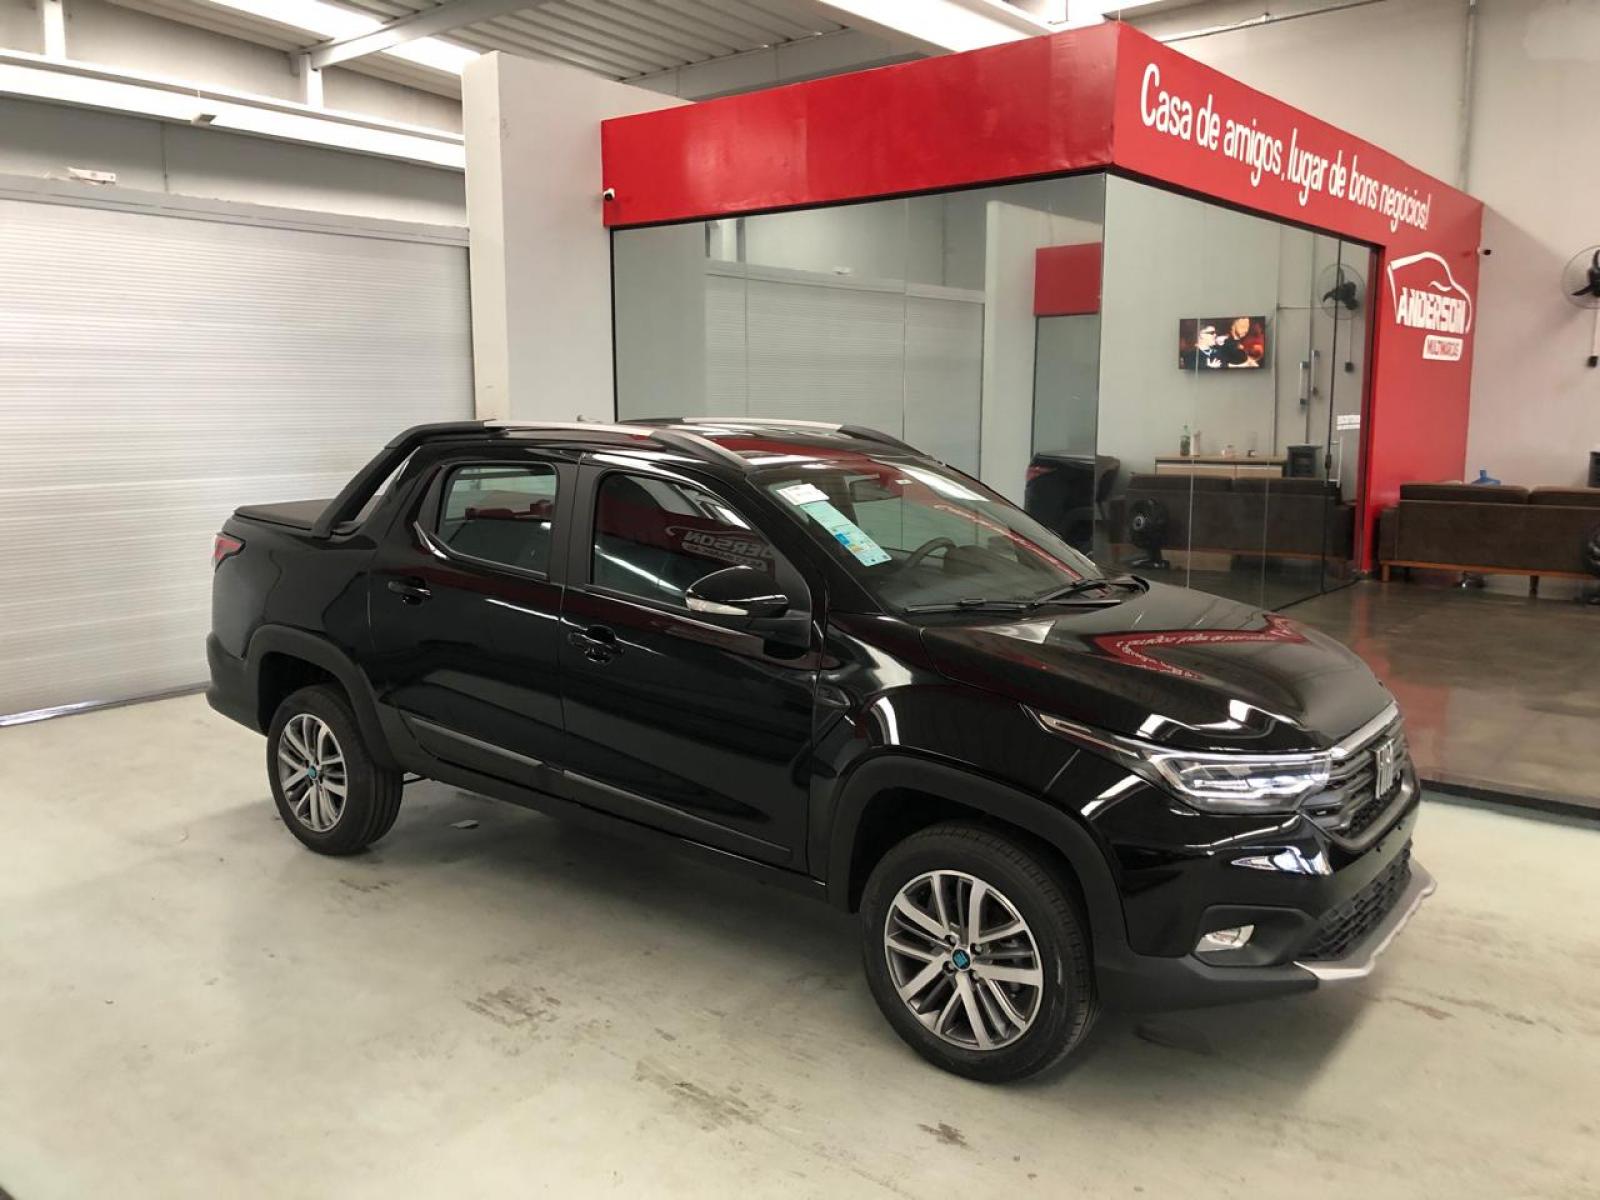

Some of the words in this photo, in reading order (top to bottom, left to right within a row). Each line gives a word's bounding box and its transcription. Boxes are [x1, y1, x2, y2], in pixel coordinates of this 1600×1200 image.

[1141, 63, 1192, 140] Casa
[1196, 93, 1220, 150] de
[1223, 118, 1285, 187] amigos,
[1287, 128, 1328, 206] lugar
[1329, 150, 1347, 198] de
[1348, 155, 1379, 210] bons
[1379, 185, 1431, 233] negócios!
[1395, 287, 1466, 334] ANDERSON
